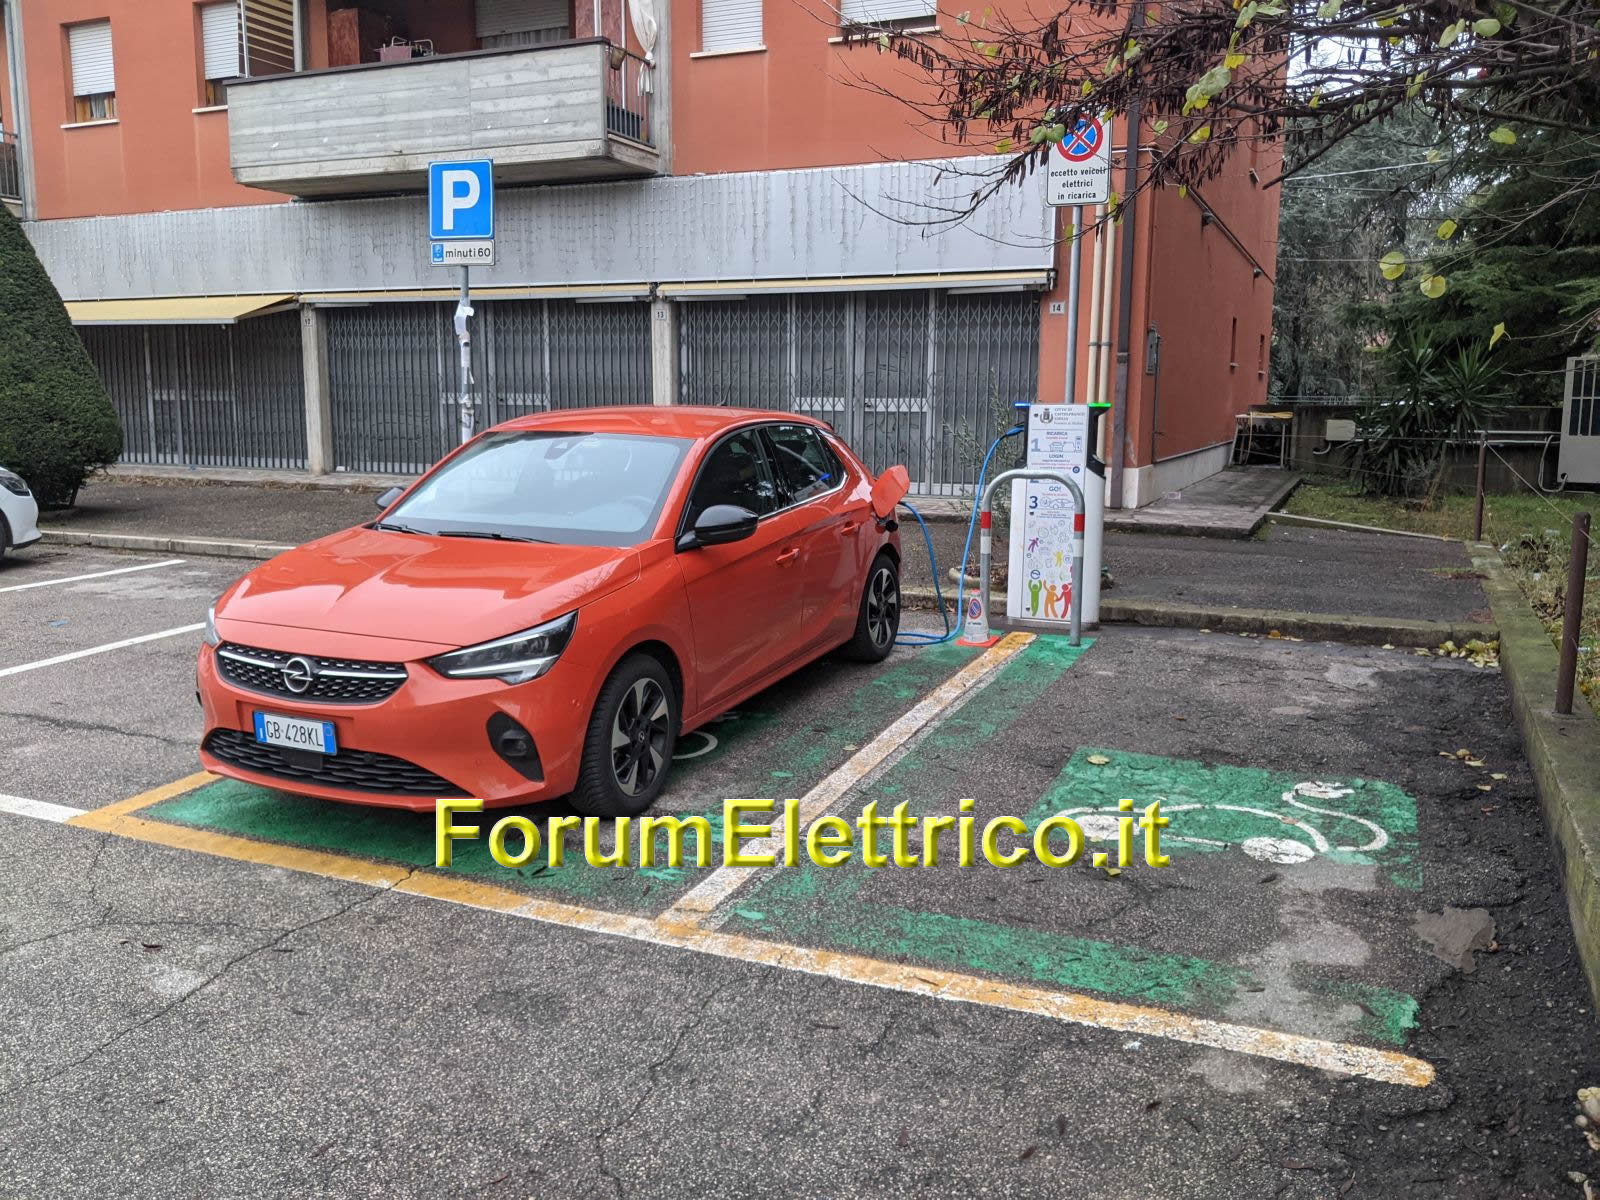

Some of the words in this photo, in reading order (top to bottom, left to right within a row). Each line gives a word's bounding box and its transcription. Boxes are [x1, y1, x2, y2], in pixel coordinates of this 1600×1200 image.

[1050, 168, 1078, 178] eccetto
[1080, 166, 1107, 176] veicoli
[1061, 179, 1094, 189] elettrici
[442, 169, 481, 231] P
[1057, 192, 1065, 200] in
[1067, 190, 1097, 200] ricarica
[445, 247, 476, 258] minuti
[477, 247, 491, 258] 60
[1052, 304, 1061, 312] 14
[1031, 438, 1041, 452] 1
[1028, 495, 1038, 509] 3
[285, 723, 324, 747] 428KL
